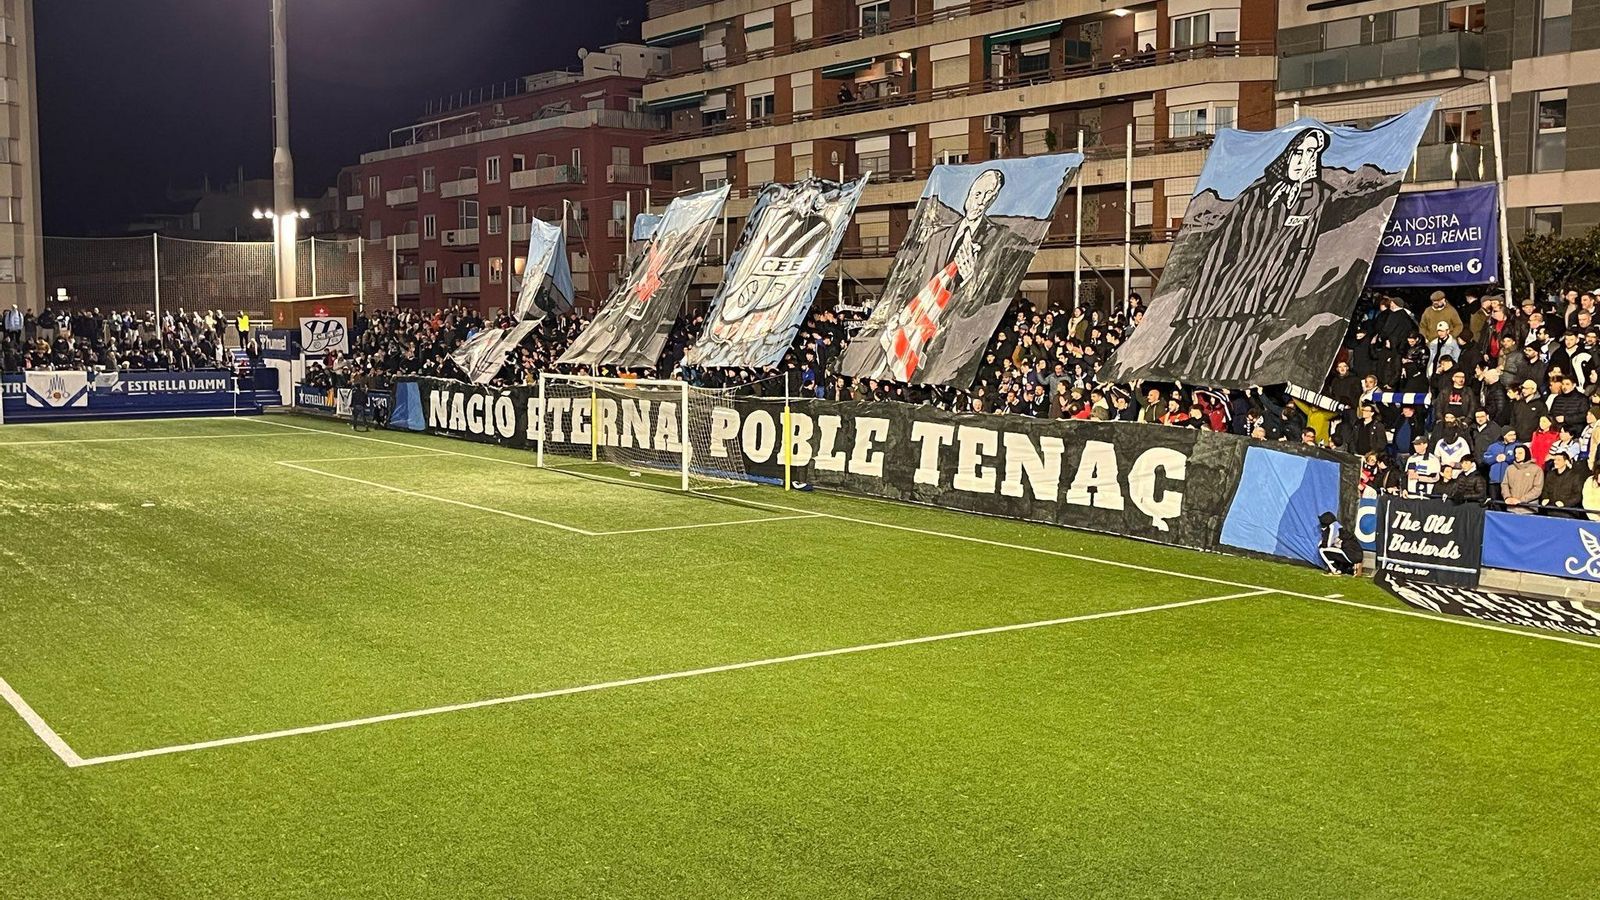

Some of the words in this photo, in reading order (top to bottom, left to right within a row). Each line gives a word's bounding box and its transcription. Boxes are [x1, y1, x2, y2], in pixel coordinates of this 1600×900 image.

[1405, 214, 1460, 231] NOSTRA
[1382, 234, 1411, 247] ORA
[1415, 232, 1437, 246] DEL
[1440, 226, 1482, 244] REMEI
[1383, 265, 1406, 275] Grup
[1408, 264, 1430, 273] Salut
[1431, 262, 1463, 273] Remei
[128, 379, 187, 391] ESTRELLA
[188, 378, 226, 391] DAMM
[304, 394, 324, 406] ESTRELLA
[429, 390, 516, 438] NACIÓ
[709, 406, 891, 478] POBLE
[910, 421, 1188, 532] TENAÇ
[1391, 510, 1421, 531] The
[1423, 514, 1455, 535] Old
[1388, 533, 1461, 560] Bastards
